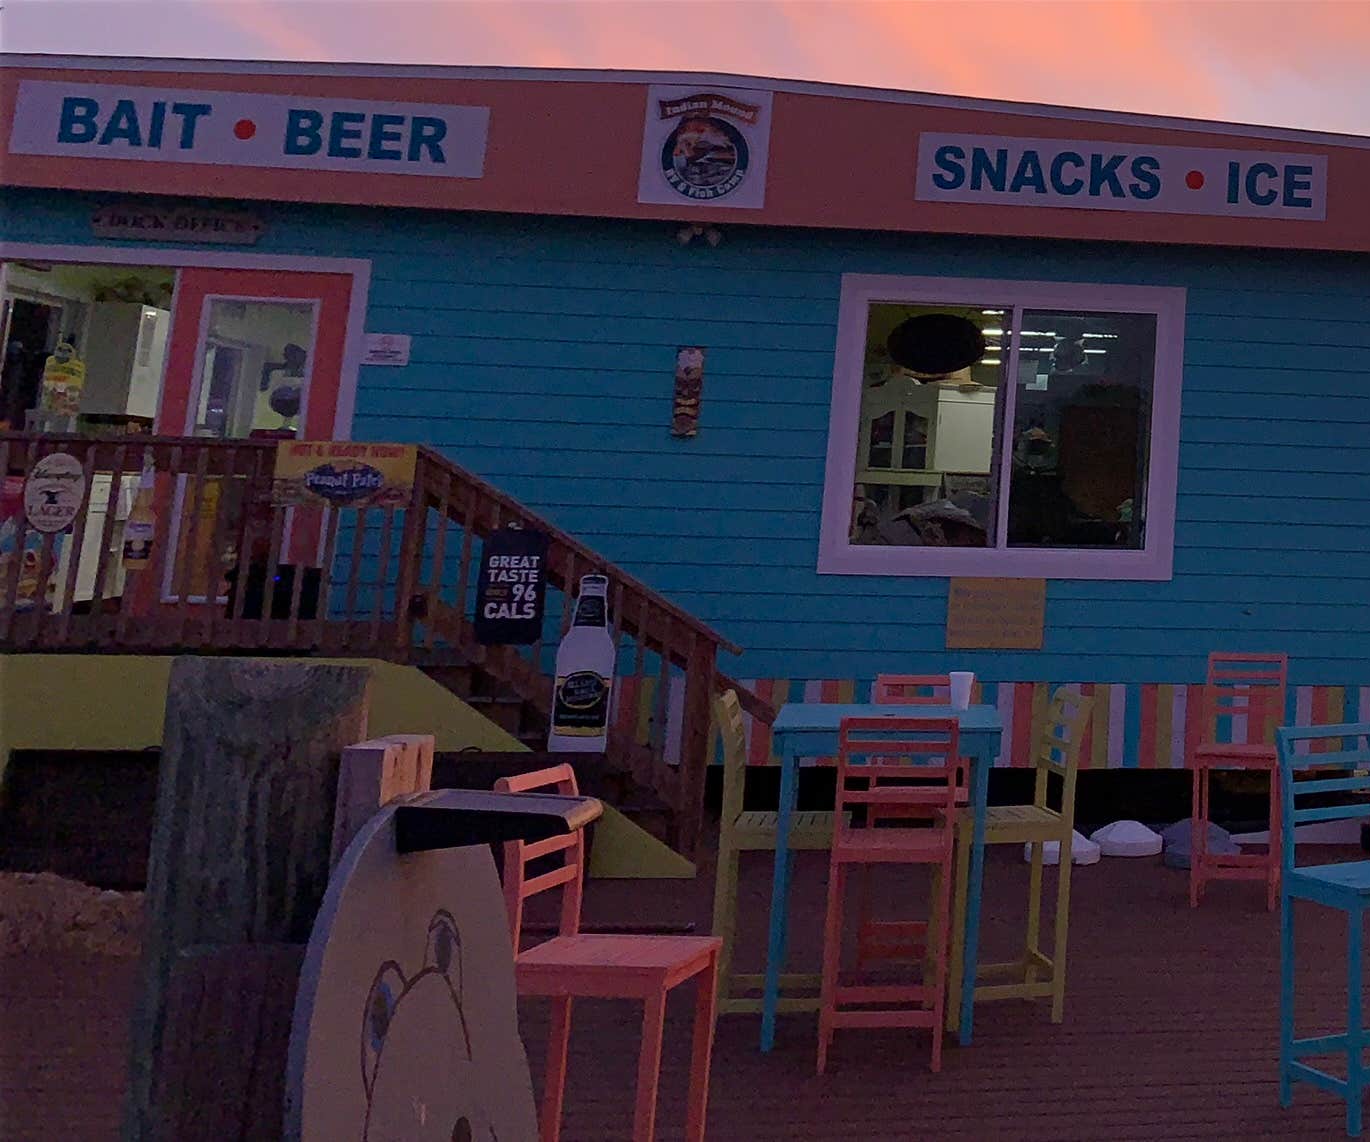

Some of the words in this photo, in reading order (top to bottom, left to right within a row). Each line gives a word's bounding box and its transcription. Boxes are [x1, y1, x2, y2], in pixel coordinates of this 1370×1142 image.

[665, 101, 708, 115] Indian
[57, 96, 212, 150] BAIT
[283, 108, 448, 164] BEER
[931, 145, 1161, 200] SNACKS
[1226, 160, 1313, 208] ICE
[305, 471, 348, 487] Peanut
[488, 555, 541, 569] GREAT
[487, 569, 539, 583] TASTE
[512, 584, 537, 602] 96
[483, 602, 536, 620] CALS
